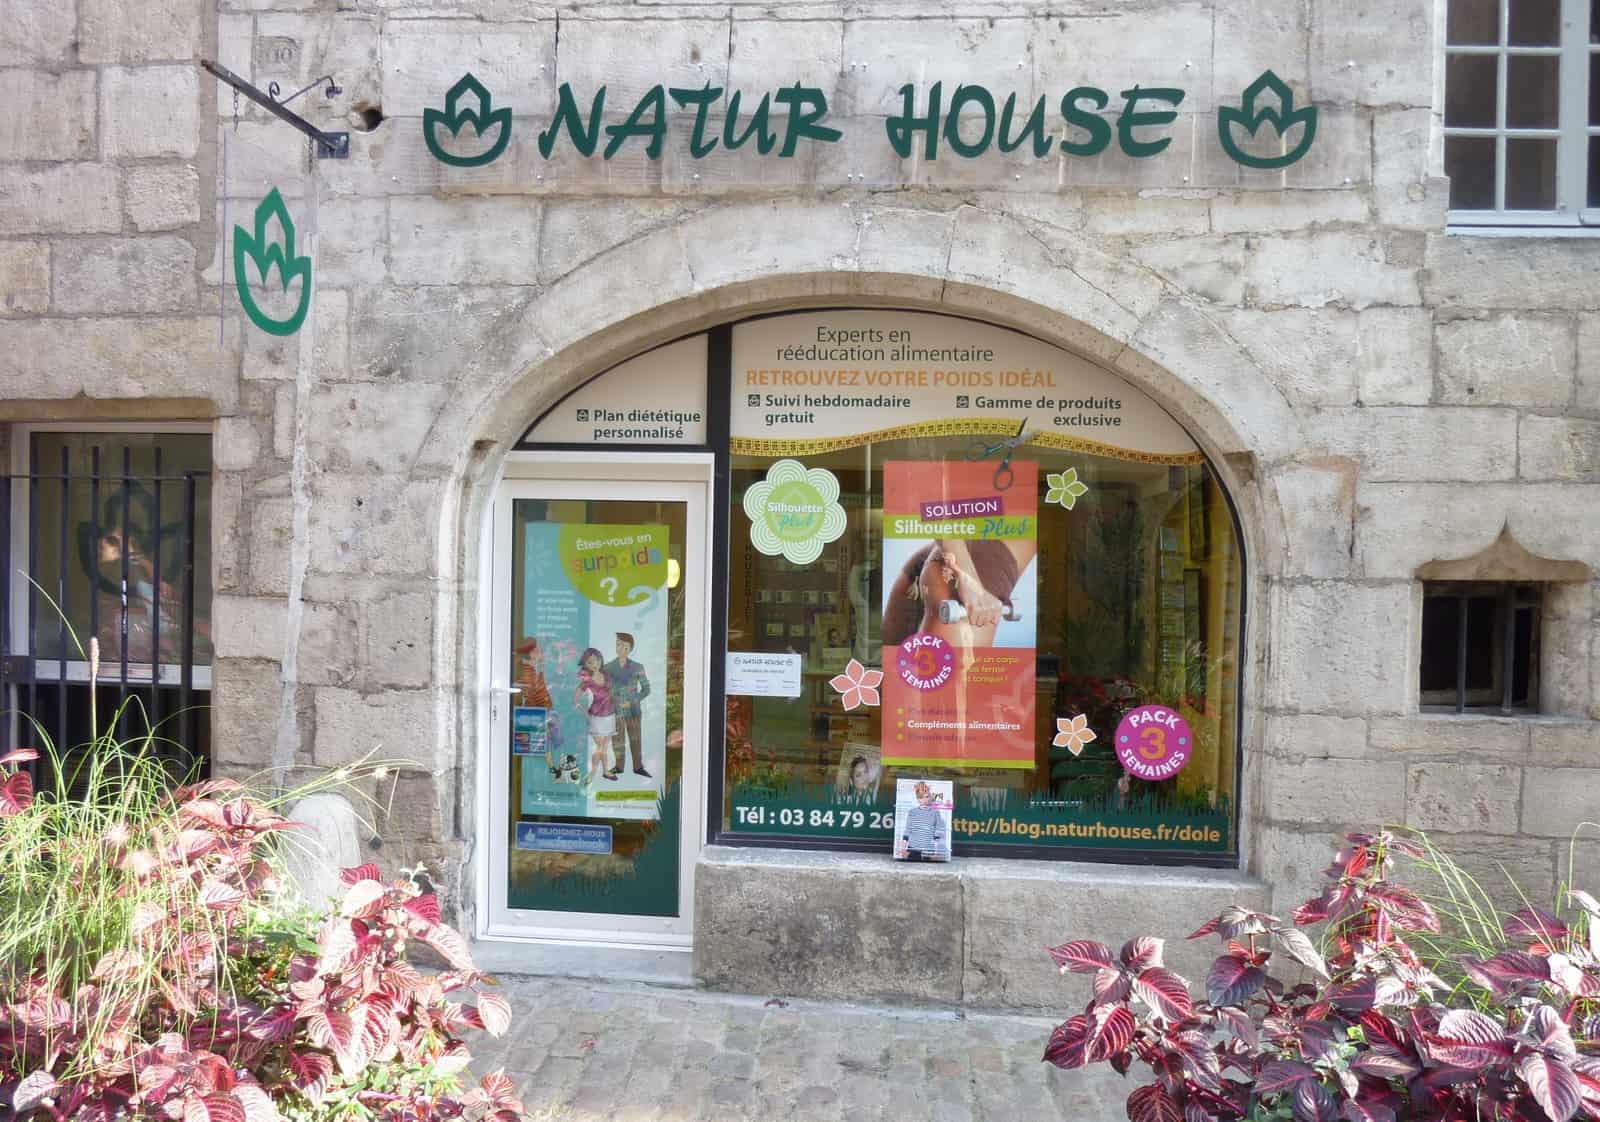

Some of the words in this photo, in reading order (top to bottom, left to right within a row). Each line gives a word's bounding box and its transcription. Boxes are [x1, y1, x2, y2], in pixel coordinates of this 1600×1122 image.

[538, 81, 843, 160] NATUR
[886, 78, 1186, 161] HOUSE
[817, 327, 883, 347] Experts
[890, 330, 911, 342] en
[777, 344, 885, 362] rééducation
[890, 345, 993, 362] alimentaire
[746, 370, 860, 386] RETROUVEZ
[865, 370, 929, 387] VOTRE
[933, 370, 993, 387] POIDS
[999, 368, 1056, 388] IDÉAL
[766, 395, 799, 408] Suivi
[804, 395, 911, 408] hebdomadaire
[976, 396, 1032, 409] Gamme
[1037, 396, 1054, 409] de
[1058, 396, 1121, 413] produits
[594, 410, 624, 422] Plan
[628, 410, 701, 424] diététique
[766, 411, 814, 427] gratuit
[1054, 413, 1121, 427] exclusive
[594, 426, 684, 441] personnalisé
[767, 502, 824, 513] Silhouette
[926, 500, 998, 518] SOLUTION
[895, 519, 976, 535] Silhouette
[982, 517, 1029, 541] Plus
[637, 534, 652, 543] en
[903, 635, 943, 653] PACK
[915, 650, 936, 676] 3
[902, 665, 952, 689] SEMAINES
[907, 720, 967, 730] Compléments
[968, 720, 1021, 730] alimentaires
[1129, 710, 1180, 729] PACK
[1139, 727, 1167, 760] 3
[1121, 749, 1185, 776] SEMAINES
[736, 806, 764, 824] Tél
[769, 811, 775, 824] :
[780, 808, 804, 826] 03
[809, 810, 834, 827] 84
[839, 811, 865, 828] 79
[869, 812, 894, 829] 26
[953, 818, 1221, 843] ttp://blog.naturhouse.fr/dole
